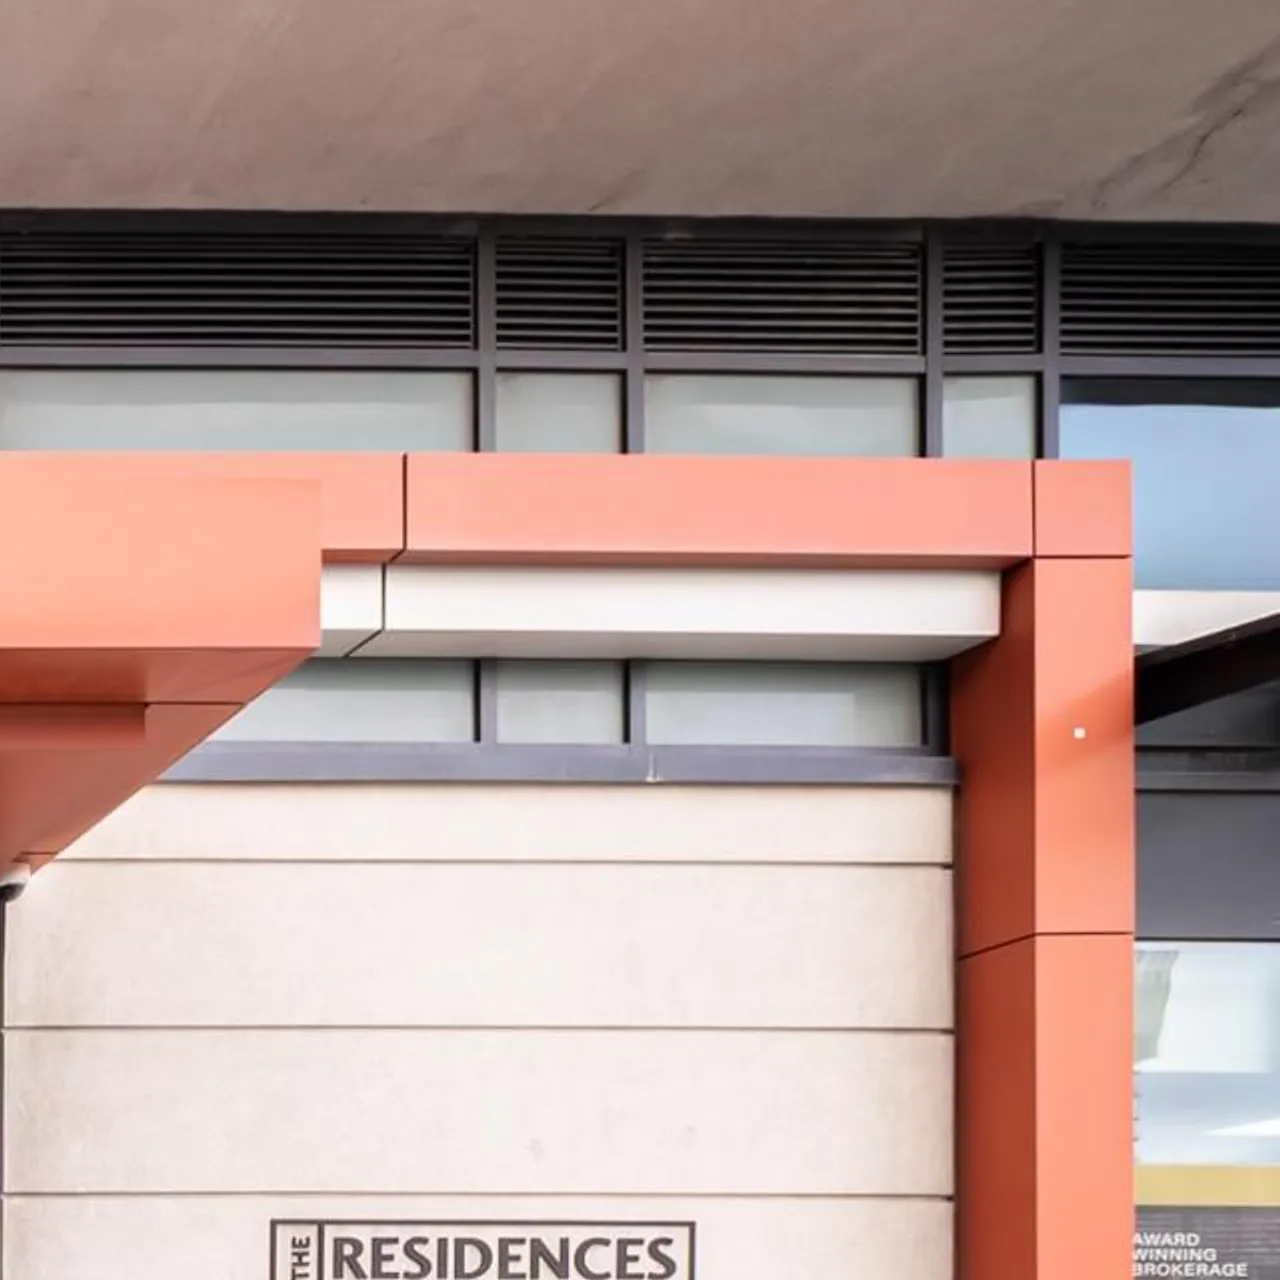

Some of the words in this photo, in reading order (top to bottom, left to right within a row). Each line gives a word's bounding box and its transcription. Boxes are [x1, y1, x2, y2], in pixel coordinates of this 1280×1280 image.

[1133, 1232, 1200, 1246] AWARD
[332, 1236, 677, 1280] RESIDENCES
[1133, 1248, 1217, 1261] WINNING
[1133, 1263, 1248, 1277] BROKERAGE
